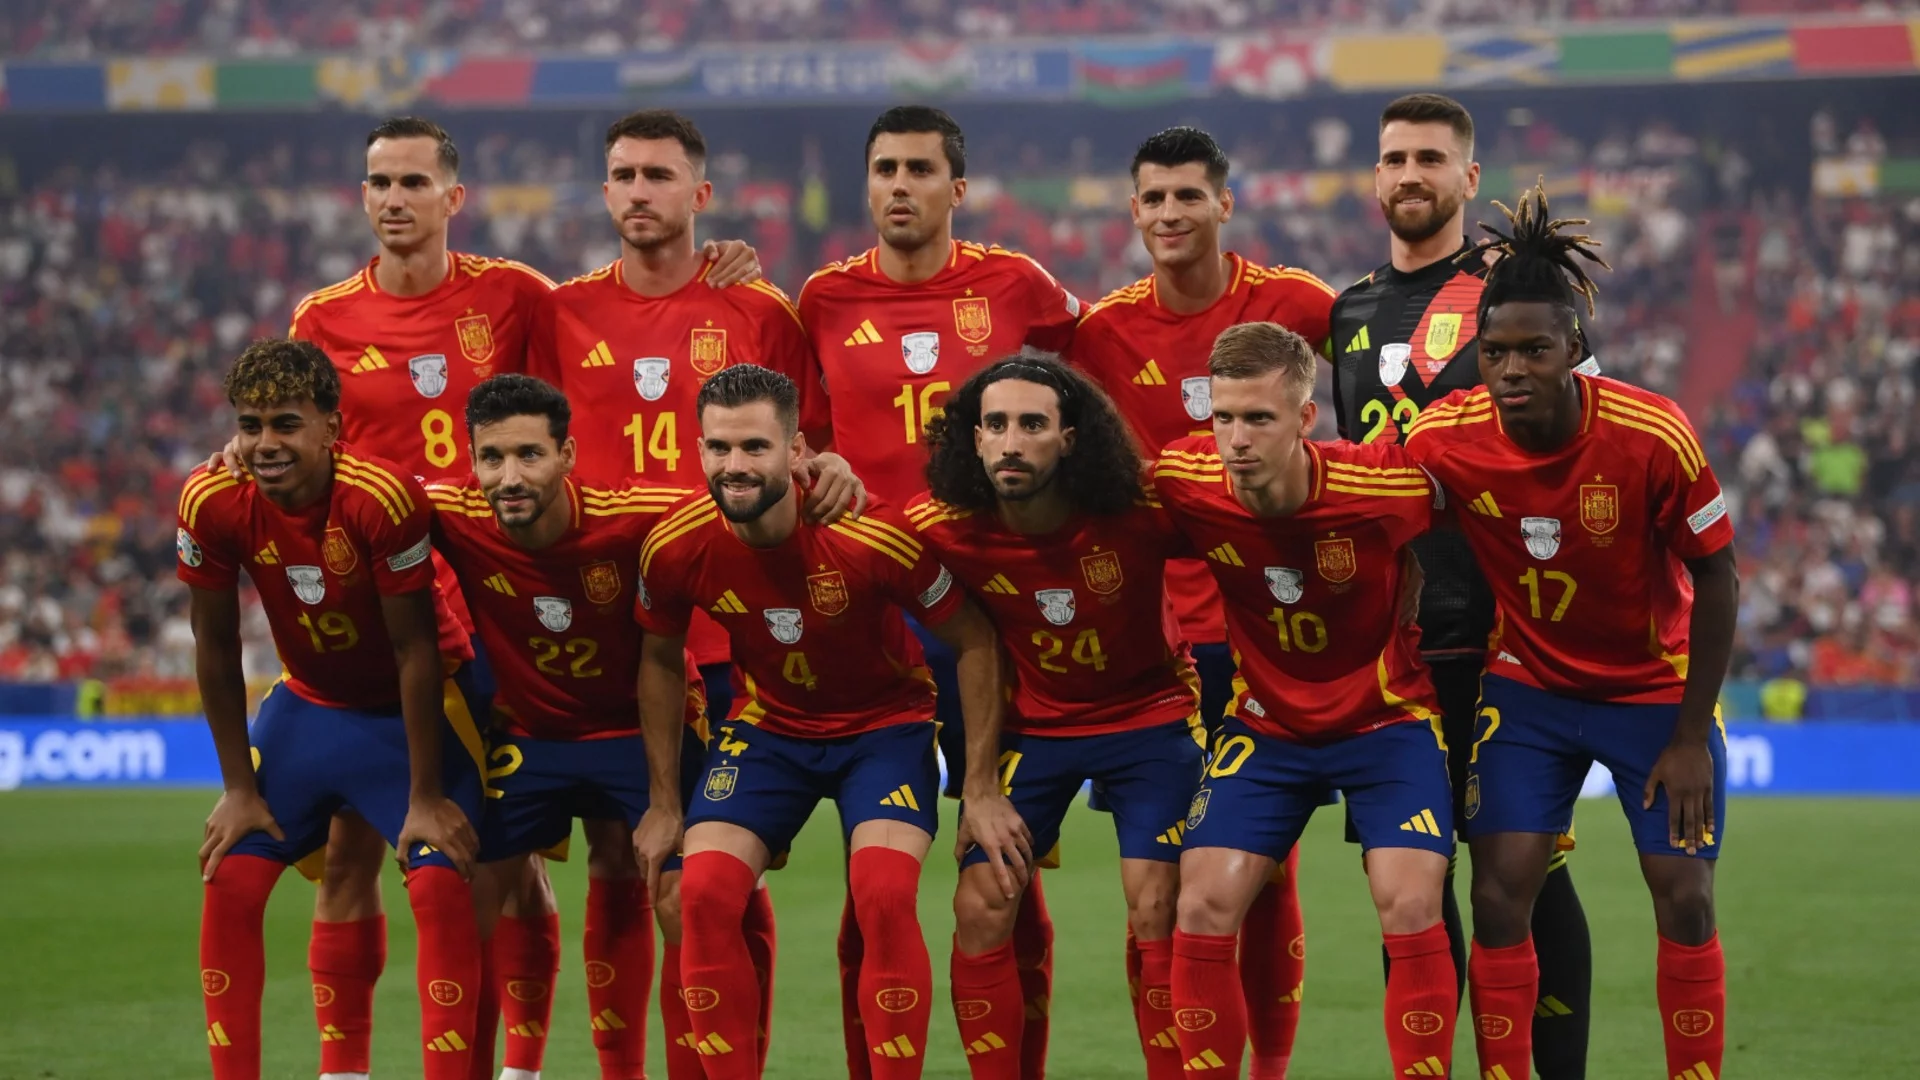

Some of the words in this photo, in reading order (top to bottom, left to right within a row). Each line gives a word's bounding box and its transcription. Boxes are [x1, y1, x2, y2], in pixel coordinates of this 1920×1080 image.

[894, 381, 951, 444] 16
[421, 408, 457, 468] 8
[623, 411, 681, 473] 14
[1519, 567, 1578, 621] 17
[297, 610, 360, 653] 19
[1031, 628, 1108, 673] 24
[1267, 607, 1329, 653] 10
[529, 636, 602, 678] 22
[782, 652, 818, 690] 4
[719, 726, 749, 756] 4
